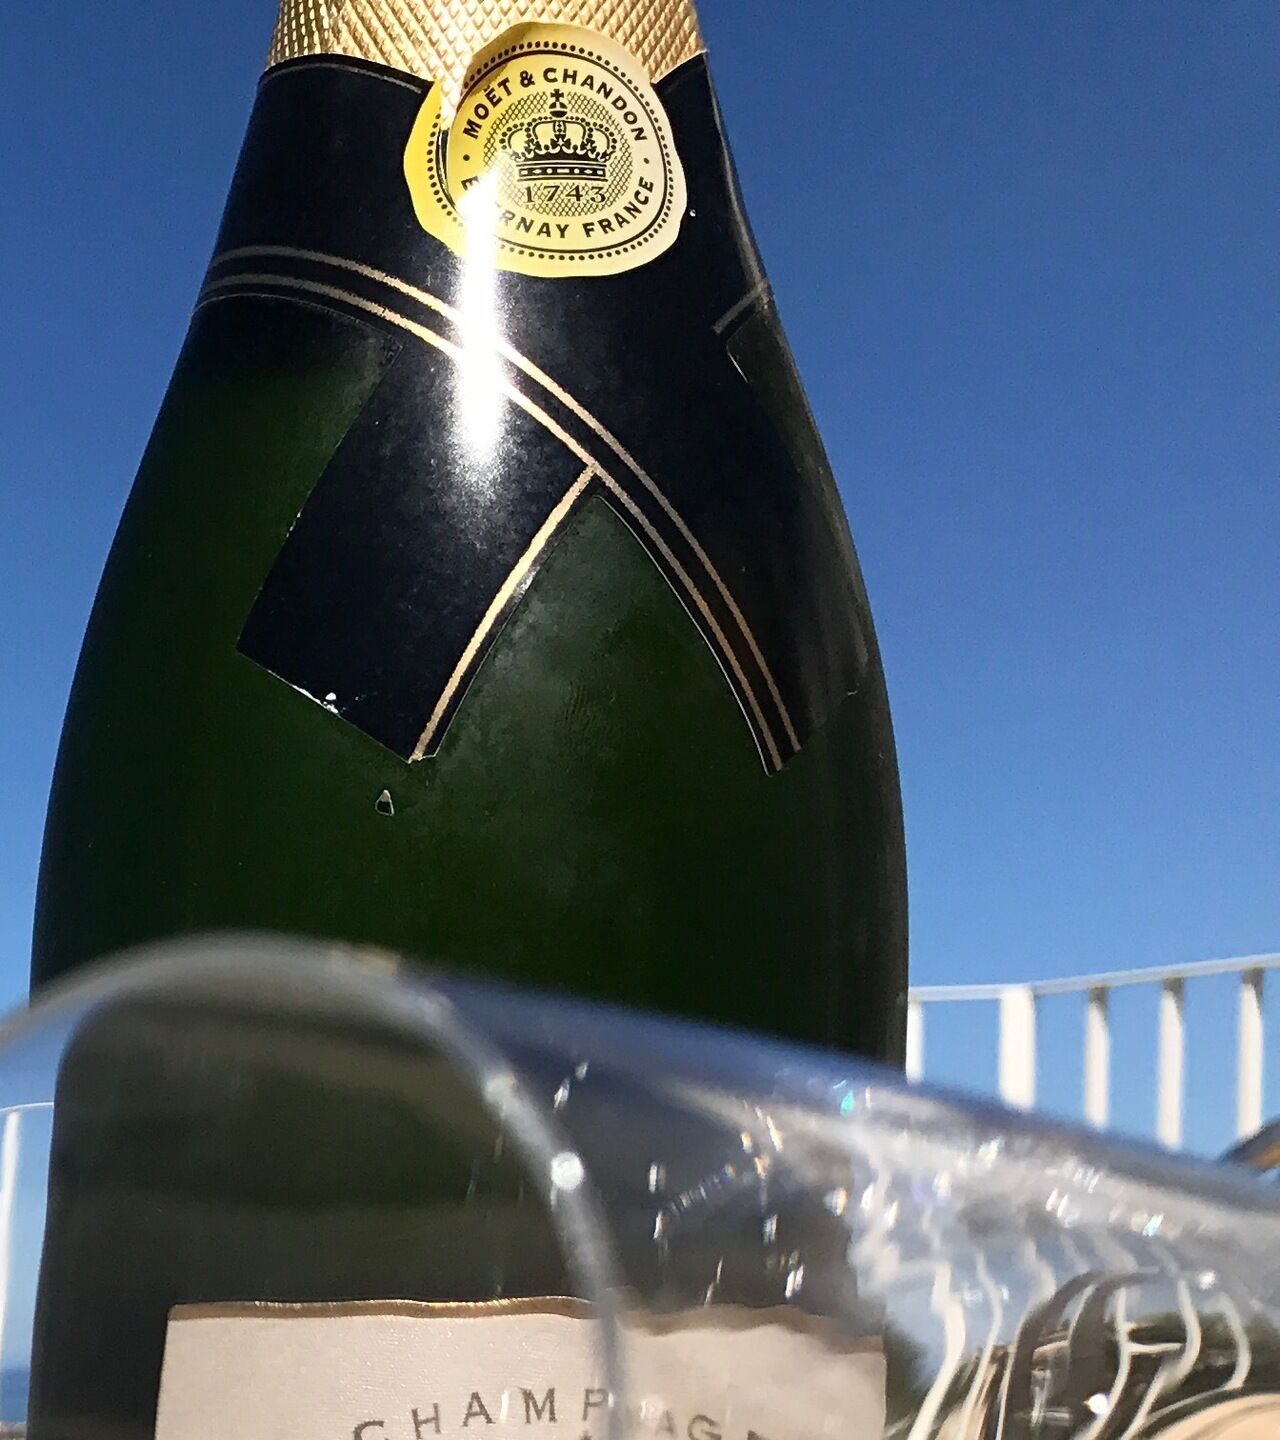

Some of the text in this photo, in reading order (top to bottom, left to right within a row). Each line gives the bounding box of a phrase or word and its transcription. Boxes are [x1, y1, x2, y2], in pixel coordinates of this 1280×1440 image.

[463, 67, 648, 143] MOËT & CHANDON
[461, 175, 654, 239] ERNAY FRANCE
[524, 184, 607, 205] 1743
